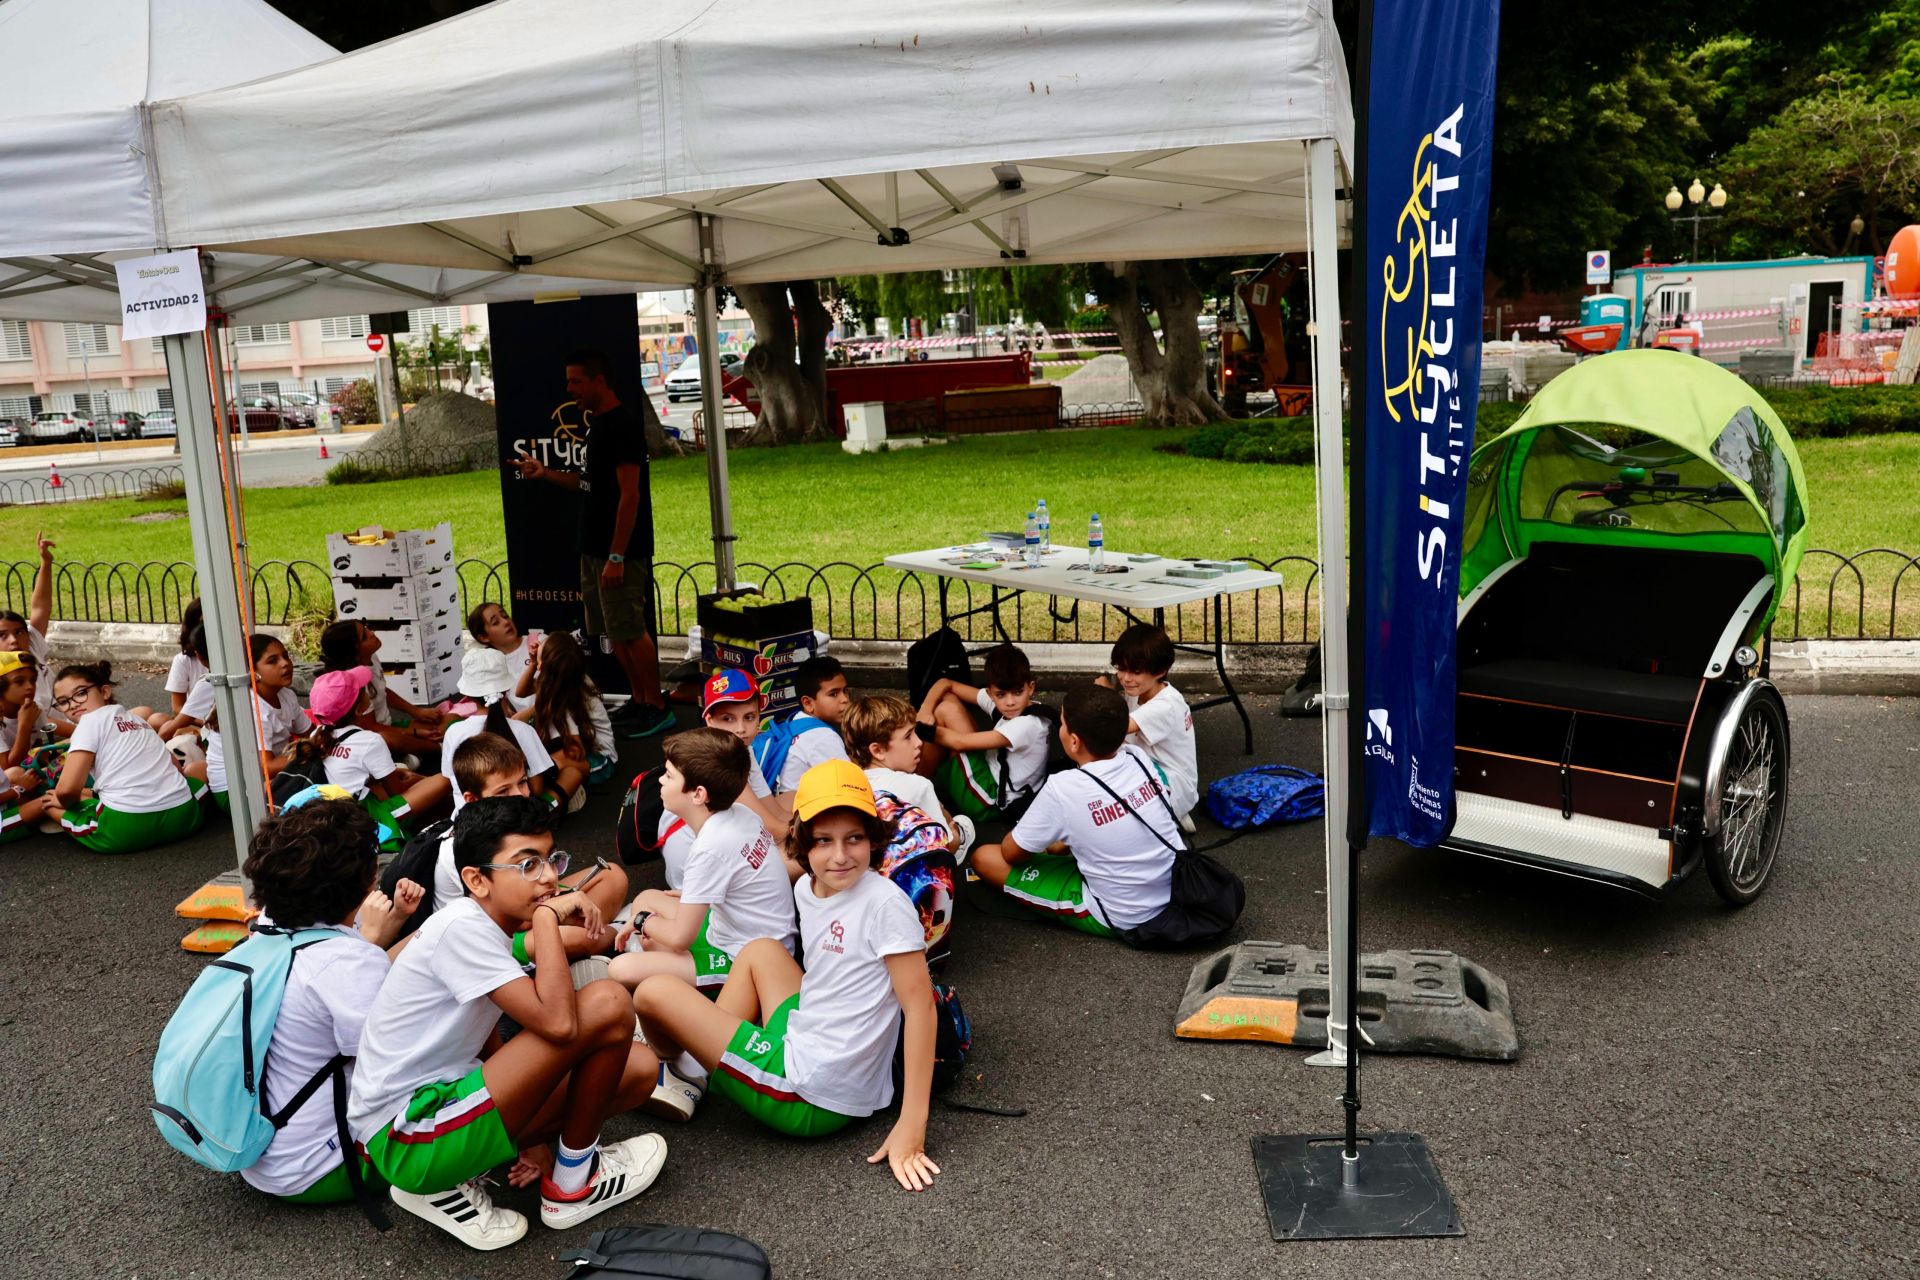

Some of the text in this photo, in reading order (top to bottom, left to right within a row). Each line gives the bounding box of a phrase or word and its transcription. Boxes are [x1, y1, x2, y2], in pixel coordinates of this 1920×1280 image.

[126, 293, 199, 314] ACTIVIDAD 2
[1417, 102, 1465, 590] SITYCLETA
[1088, 799, 1103, 811] CEIP
[1132, 798, 1145, 810] LOS
